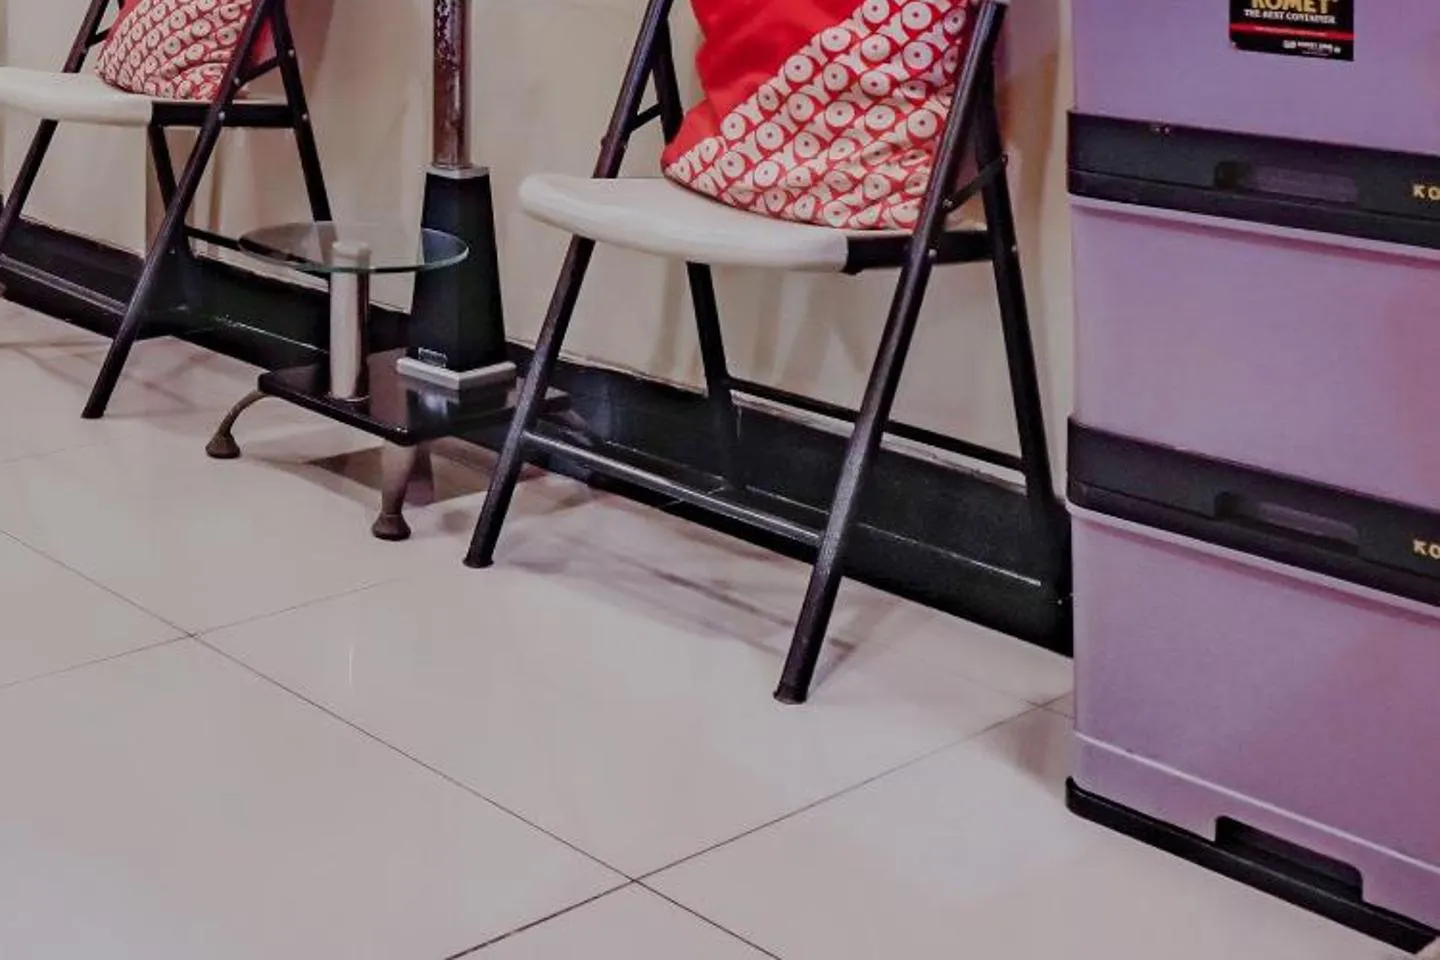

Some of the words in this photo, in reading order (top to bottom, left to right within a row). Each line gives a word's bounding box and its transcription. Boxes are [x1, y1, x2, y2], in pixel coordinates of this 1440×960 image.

[1243, 8, 1262, 19] THE
[1263, 10, 1284, 21] BEST
[1285, 12, 1336, 24] CONTAINER
